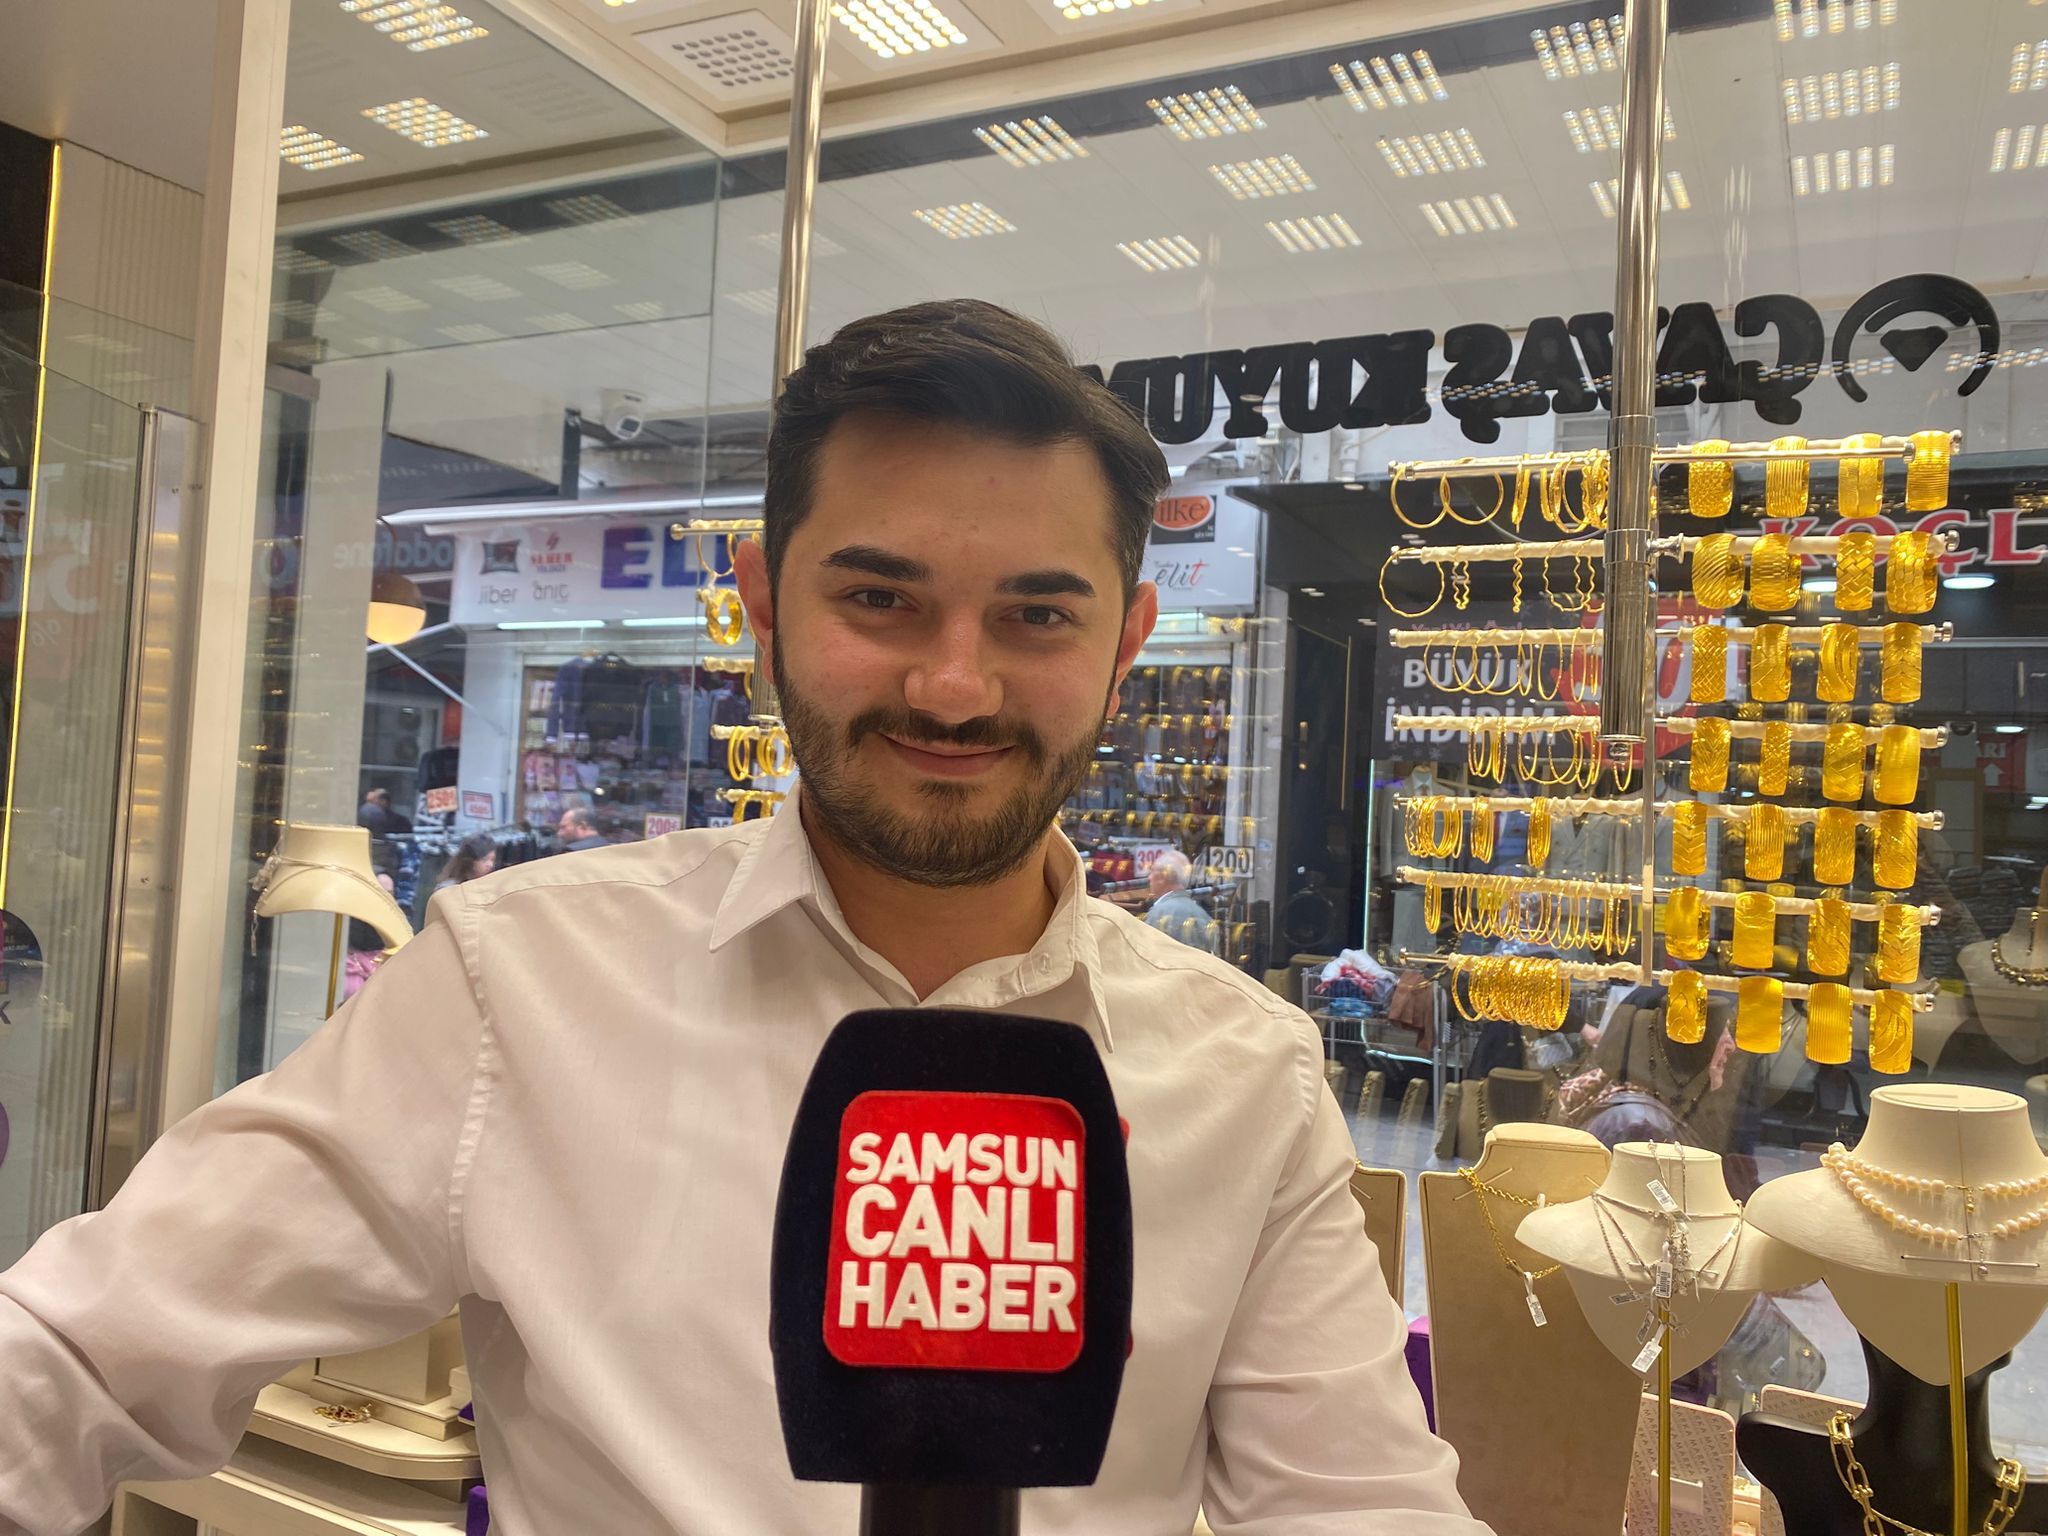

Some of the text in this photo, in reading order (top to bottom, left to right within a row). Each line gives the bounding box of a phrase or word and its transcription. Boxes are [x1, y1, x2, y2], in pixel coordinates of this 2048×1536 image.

[1154, 559, 1208, 587] elit
[1403, 652, 1531, 689] BÜYÜK
[1212, 848, 1250, 873] 200
[846, 1132, 1077, 1190] SAMSUN
[845, 1183, 1074, 1263] CANLI
[838, 1261, 1077, 1333] HABER
